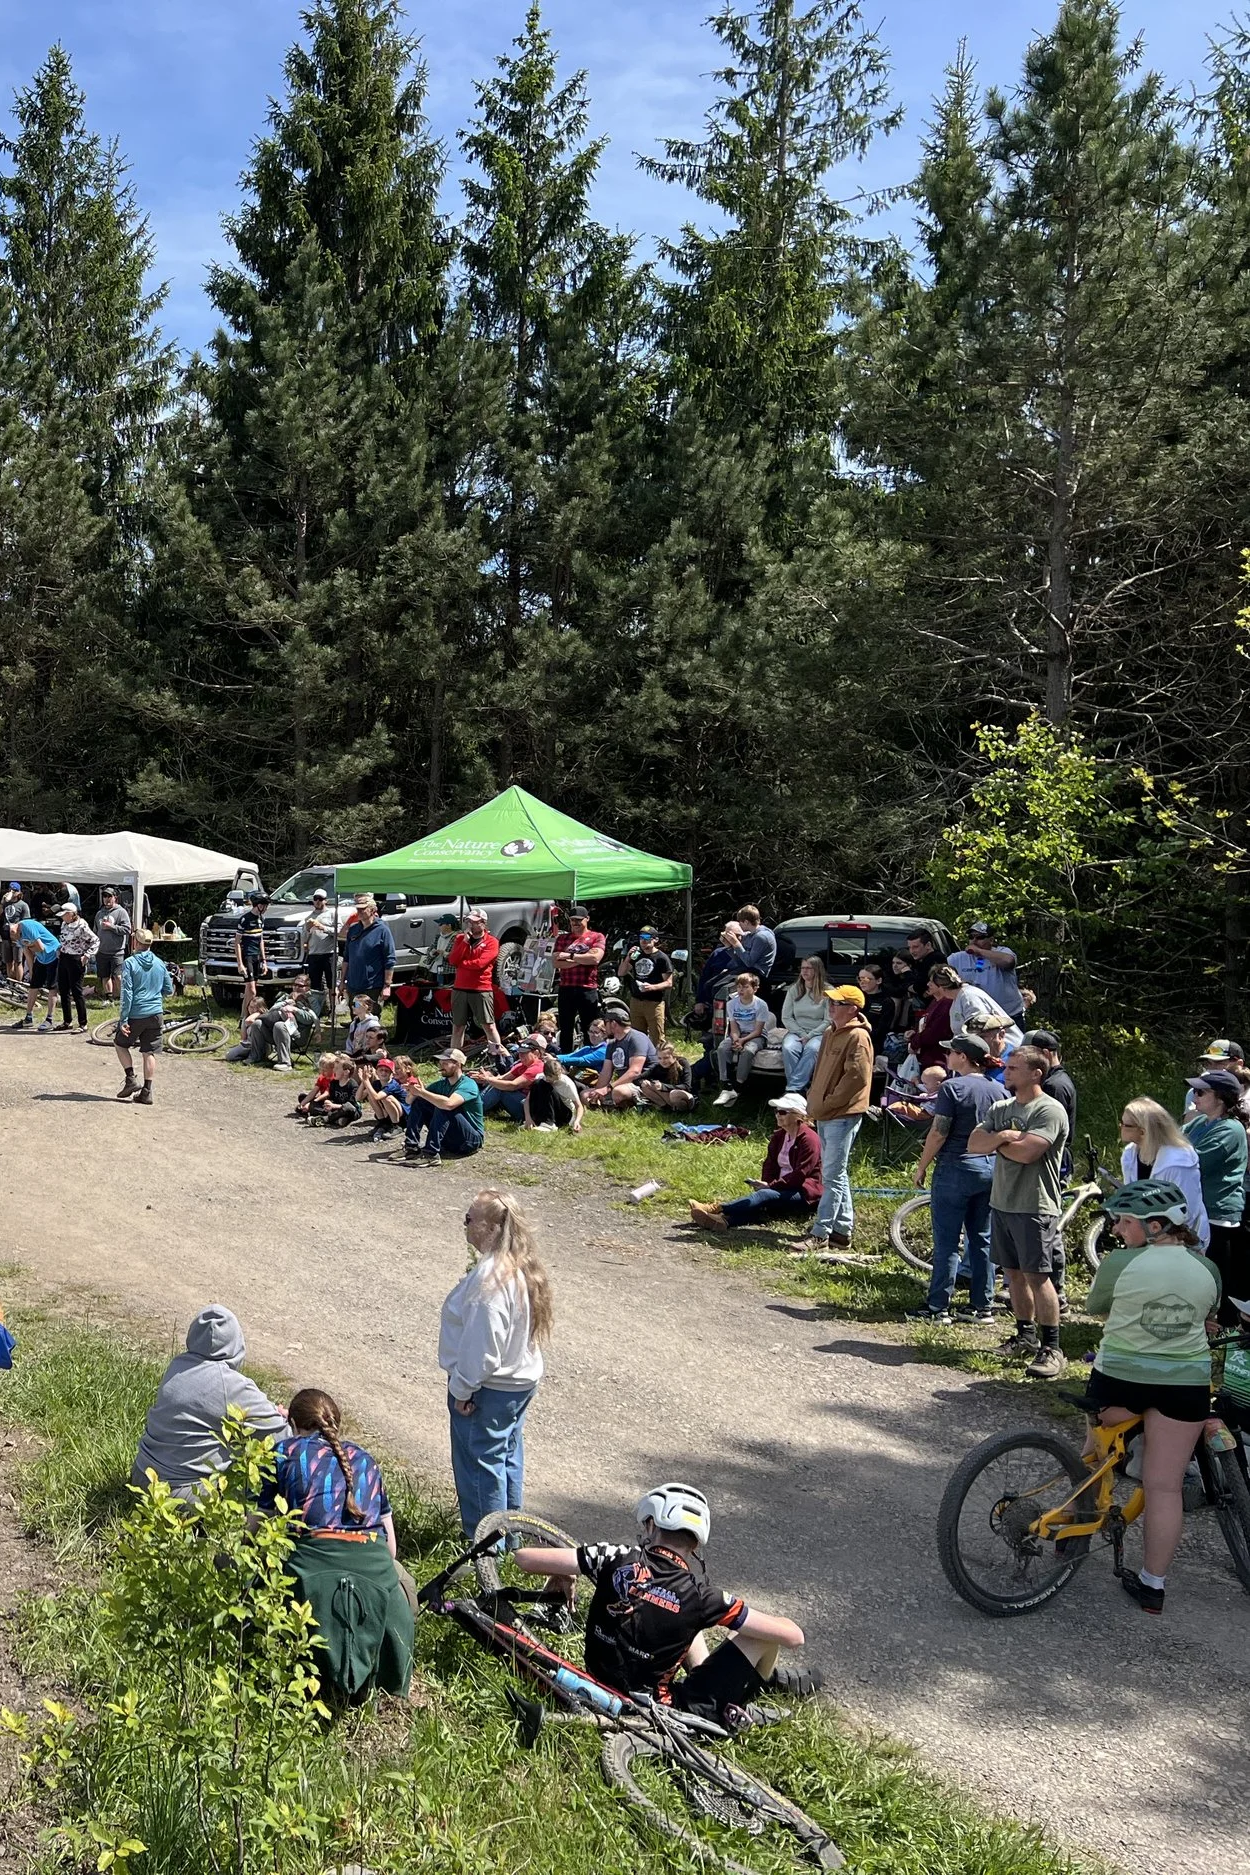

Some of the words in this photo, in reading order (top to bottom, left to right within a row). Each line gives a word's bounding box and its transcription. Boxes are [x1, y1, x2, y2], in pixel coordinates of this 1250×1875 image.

[421, 839, 442, 849] The
[440, 838, 502, 850] Nature
[413, 848, 496, 859] Conservancy
[517, 1515, 559, 1535] SCORPION
[1010, 1586, 1056, 1609] MEZCAL
